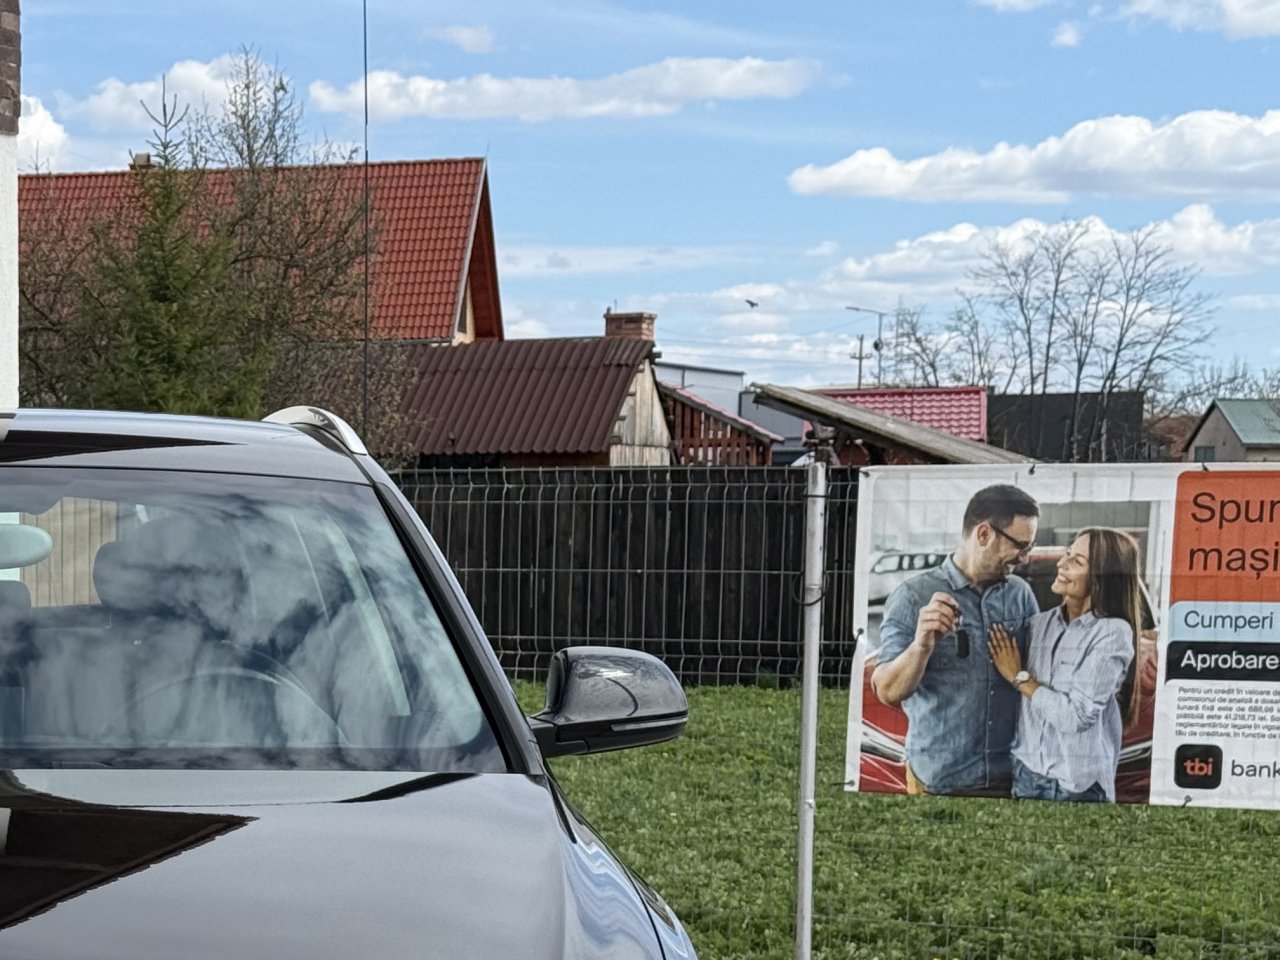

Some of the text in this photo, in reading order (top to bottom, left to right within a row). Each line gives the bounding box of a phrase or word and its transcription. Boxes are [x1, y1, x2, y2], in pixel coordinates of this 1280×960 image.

[1184, 610, 1274, 632] Cumperi
[1181, 650, 1280, 672] Aprobare
[1183, 757, 1214, 776] tbi
